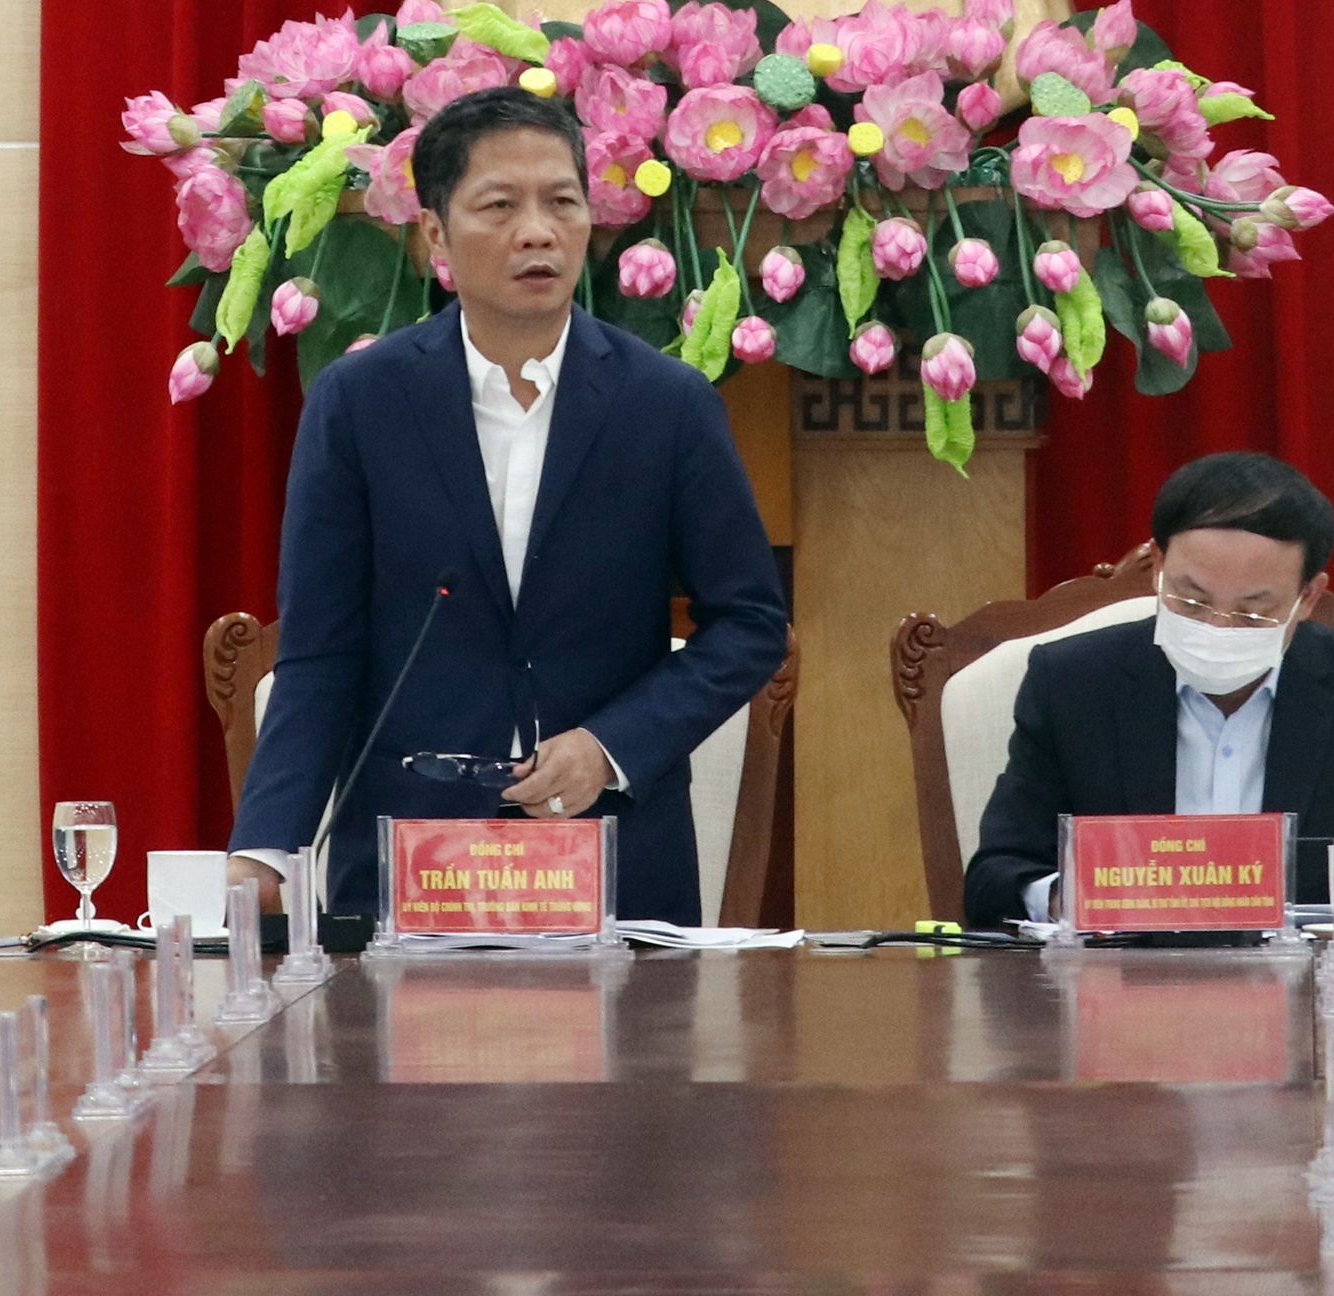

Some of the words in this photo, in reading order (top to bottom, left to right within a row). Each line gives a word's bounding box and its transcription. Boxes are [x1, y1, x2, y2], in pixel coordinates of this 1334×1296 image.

[419, 862, 471, 890] TRẦN
[477, 862, 528, 890] TUẤN
[533, 869, 575, 890] ANH
[1094, 859, 1173, 887] NGUYỄN
[1179, 861, 1233, 885] XUÂN
[1238, 860, 1265, 885] KÝ
